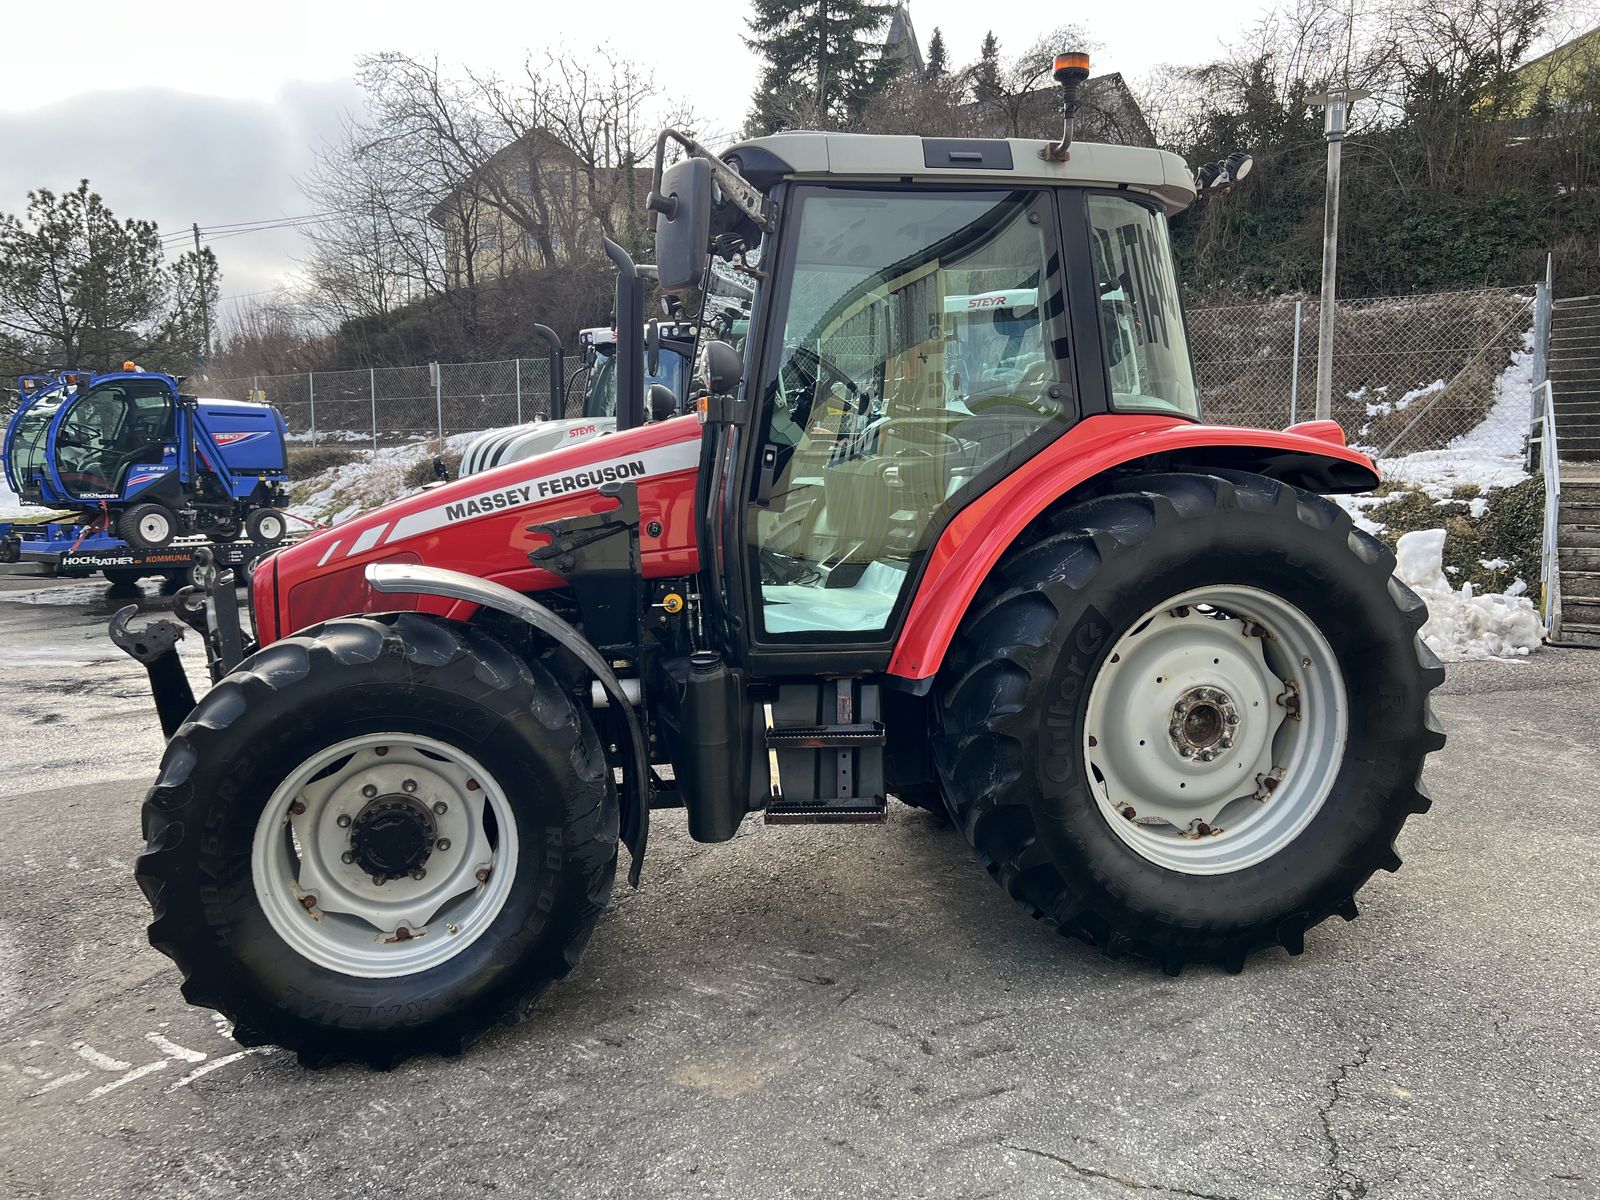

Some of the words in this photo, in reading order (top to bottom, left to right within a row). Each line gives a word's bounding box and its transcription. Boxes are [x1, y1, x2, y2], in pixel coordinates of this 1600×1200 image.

[968, 296, 1006, 309] STEYR
[569, 424, 596, 438] STEYR
[445, 486, 530, 521] MASSEY
[537, 460, 646, 497] FERGUSON
[62, 556, 134, 566] HOCHRATHER
[145, 554, 192, 563] KOMMUNAL
